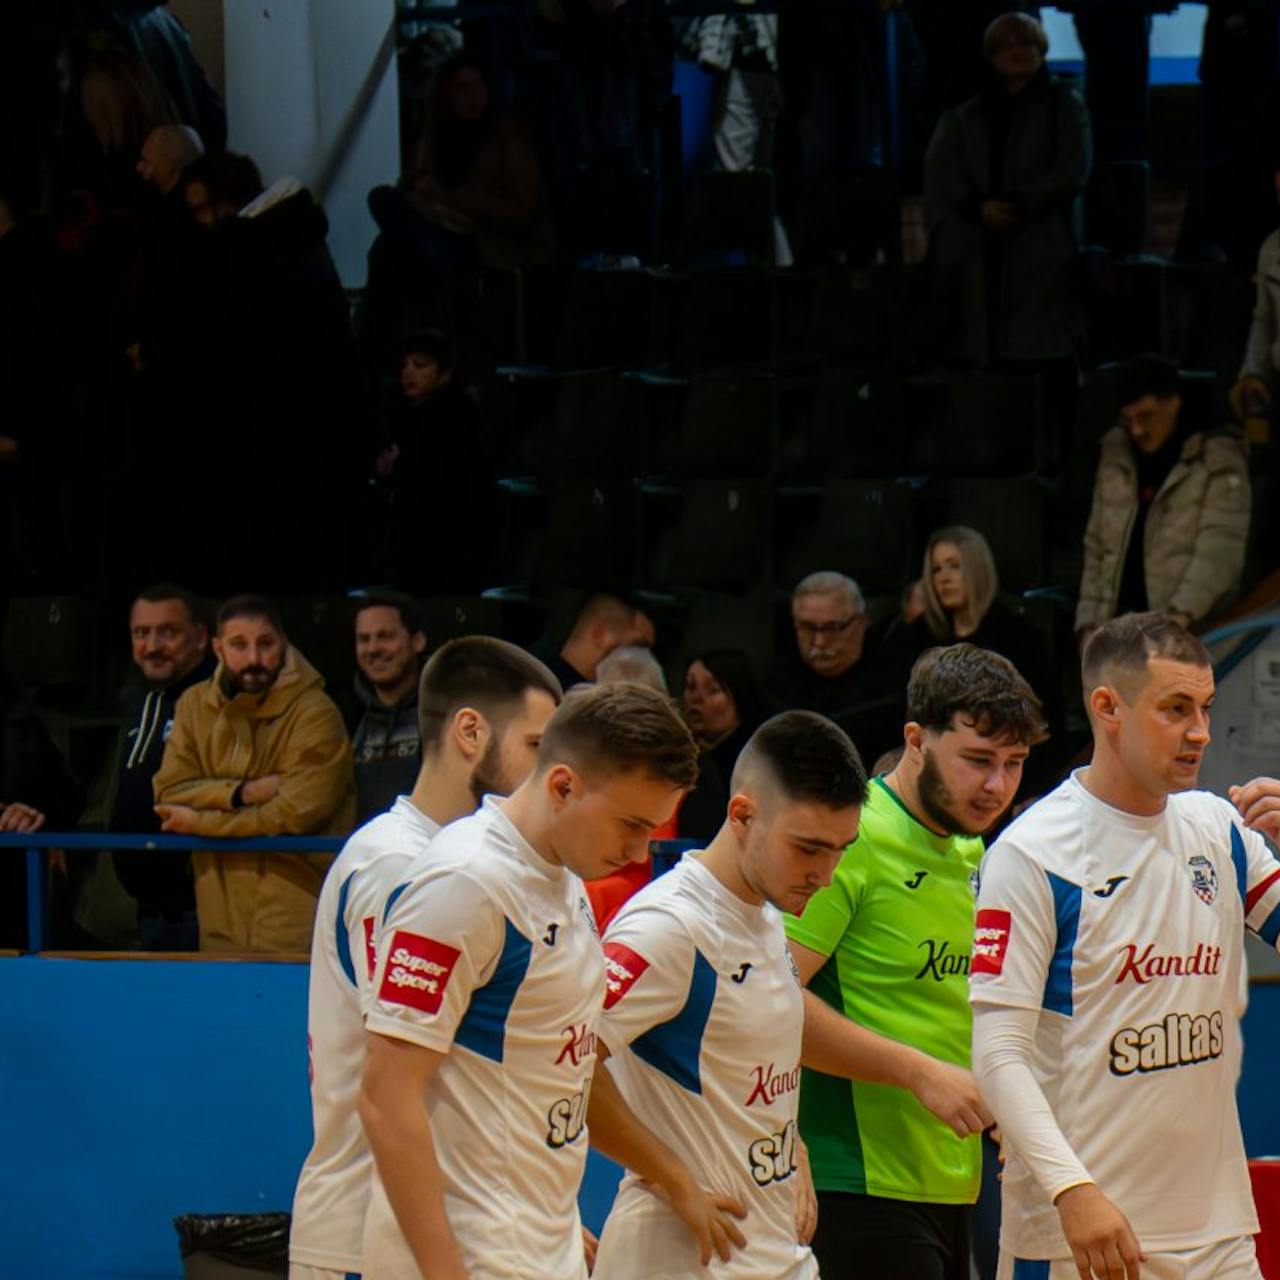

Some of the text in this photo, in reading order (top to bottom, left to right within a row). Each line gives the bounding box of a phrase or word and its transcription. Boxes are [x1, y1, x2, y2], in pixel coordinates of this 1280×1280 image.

[387, 966, 440, 996] Sport
[390, 946, 449, 977] Super
[914, 938, 970, 983] Kan
[1114, 942, 1223, 985] Kandit
[554, 1022, 597, 1067] Kan
[1108, 1009, 1225, 1077] saltas
